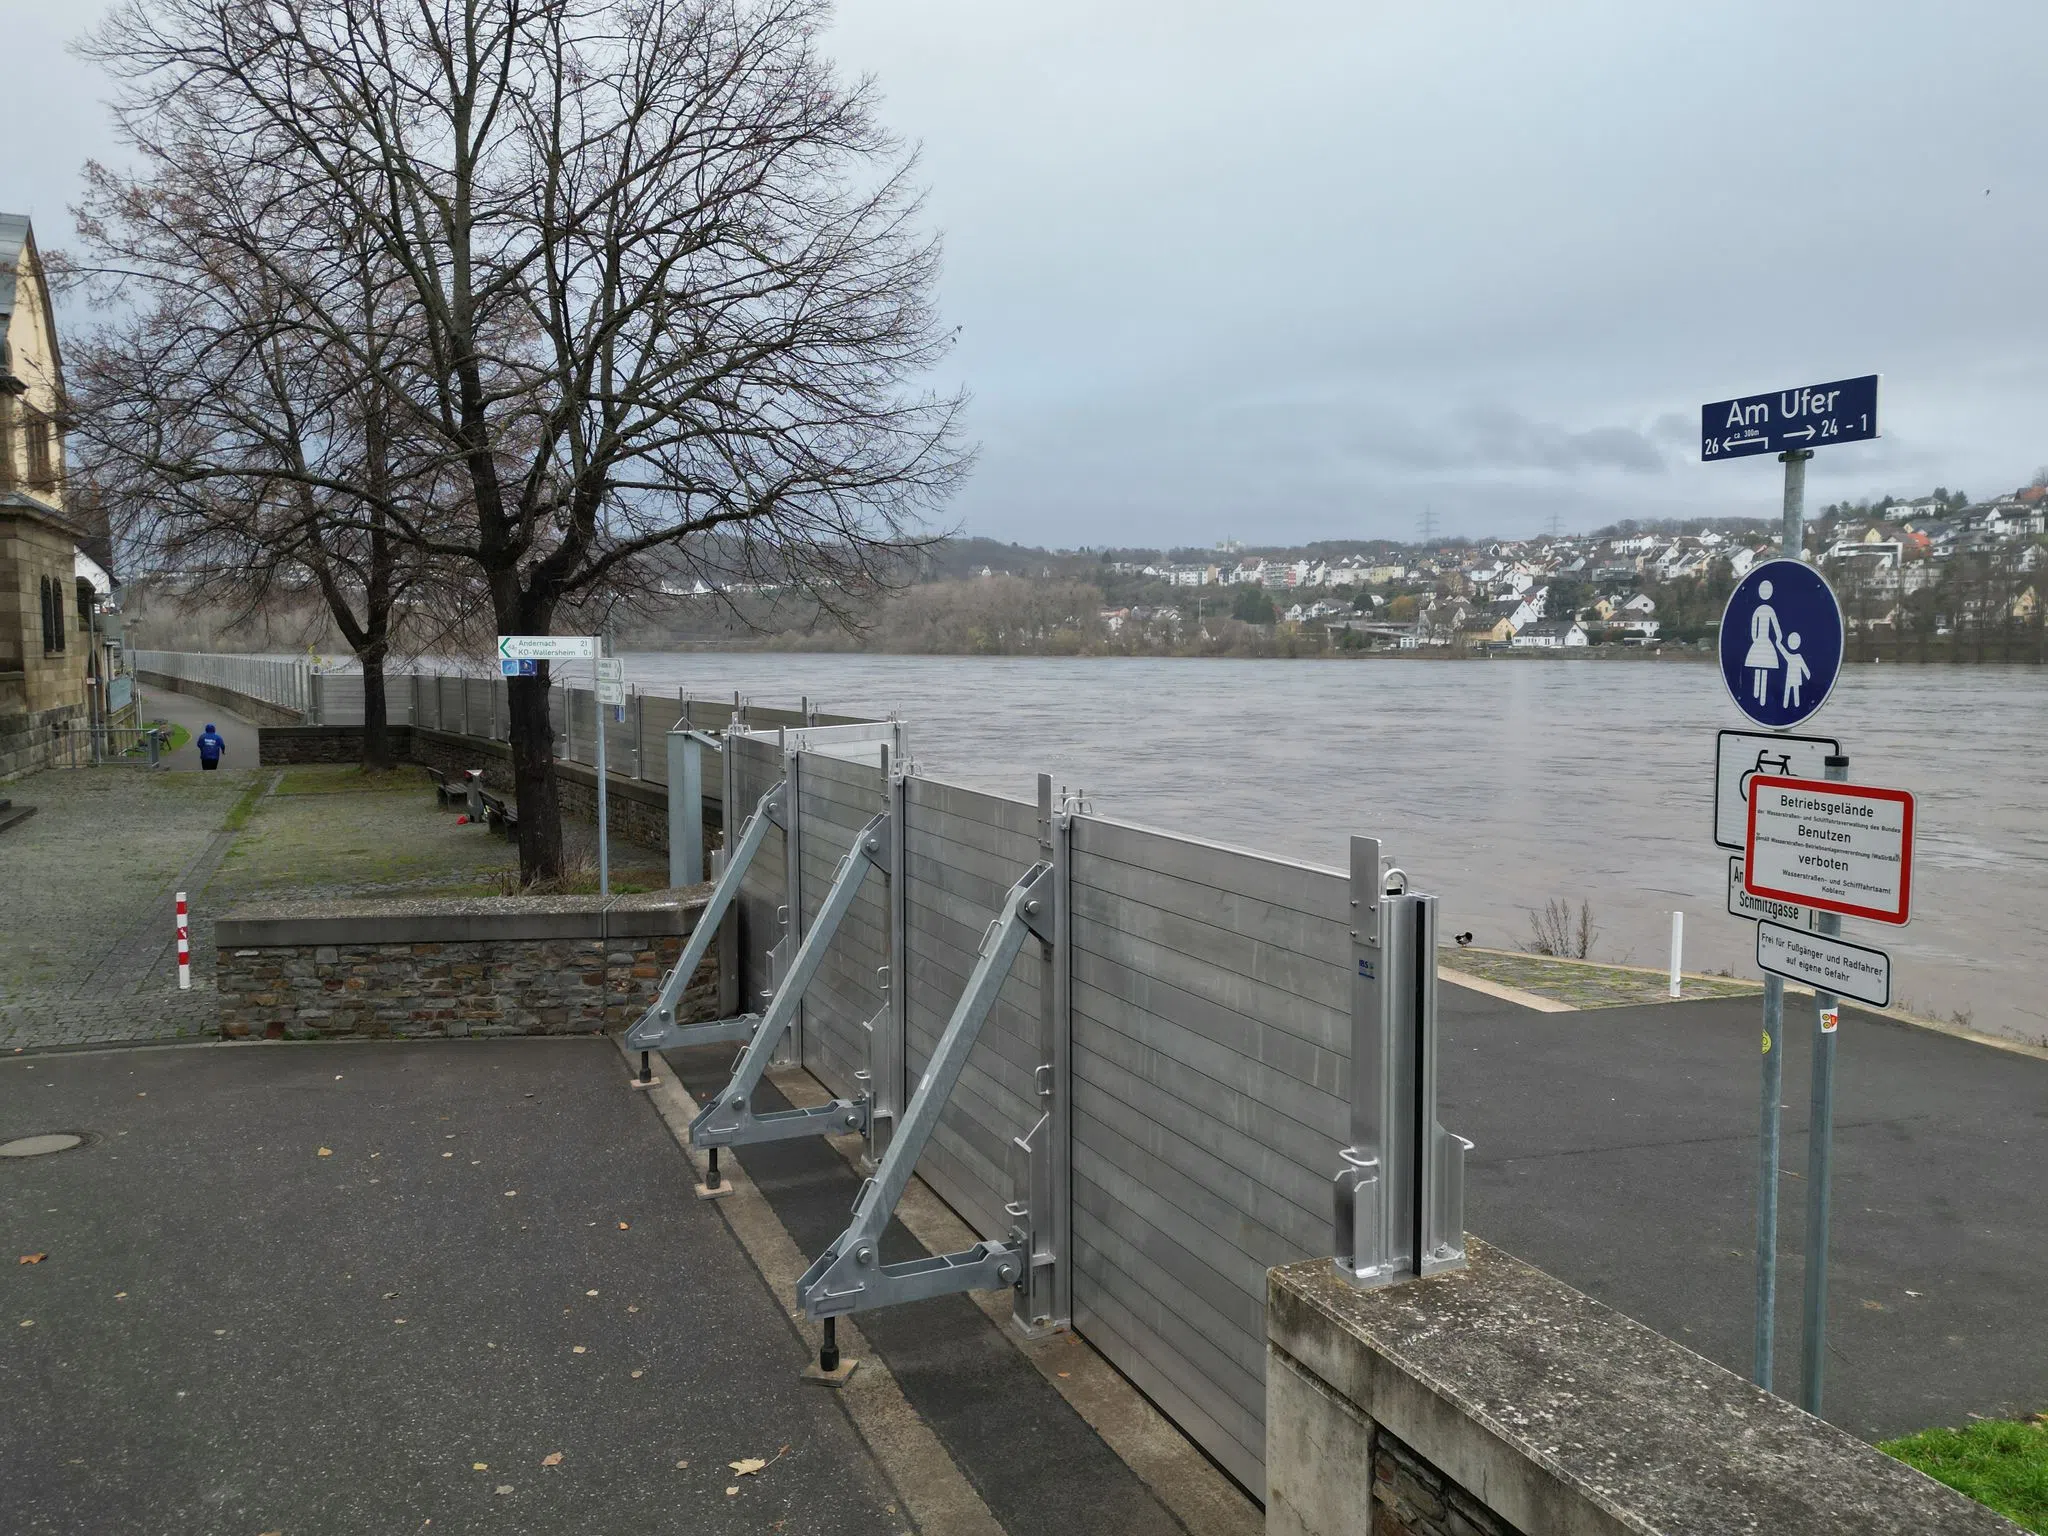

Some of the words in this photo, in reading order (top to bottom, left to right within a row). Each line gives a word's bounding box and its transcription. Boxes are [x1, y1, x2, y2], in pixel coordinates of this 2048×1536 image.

[1725, 401, 1769, 428] Am
[1781, 388, 1841, 419] Ufer
[1704, 437, 1719, 455] 26
[1744, 428, 1760, 438] 300m
[1821, 418, 1838, 438] 24
[1861, 413, 1867, 432] 1
[1780, 794, 1874, 818] Betriebsgelände
[1766, 810, 1802, 820] Wasserstraßen-
[1870, 823, 1880, 831] des
[1881, 825, 1901, 833] Bundes
[1798, 824, 1851, 844] Benutzen
[1798, 855, 1849, 872] verboten
[1782, 869, 1828, 884] Wasserstraßen-
[1829, 876, 1841, 886] und
[1842, 879, 1891, 895] Schifffahrtsamt
[1821, 885, 1846, 896] Koblenz
[1739, 890, 1799, 920] Schmitzgasse
[1761, 933, 1774, 944] Frei
[1775, 936, 1785, 947] für
[1787, 941, 1823, 960] Fußgänger
[1826, 953, 1841, 964] und
[1843, 957, 1883, 976] Radfahrer
[1786, 956, 1796, 966] auf
[1798, 960, 1822, 974] eigene
[1824, 967, 1851, 982] Gefahr
